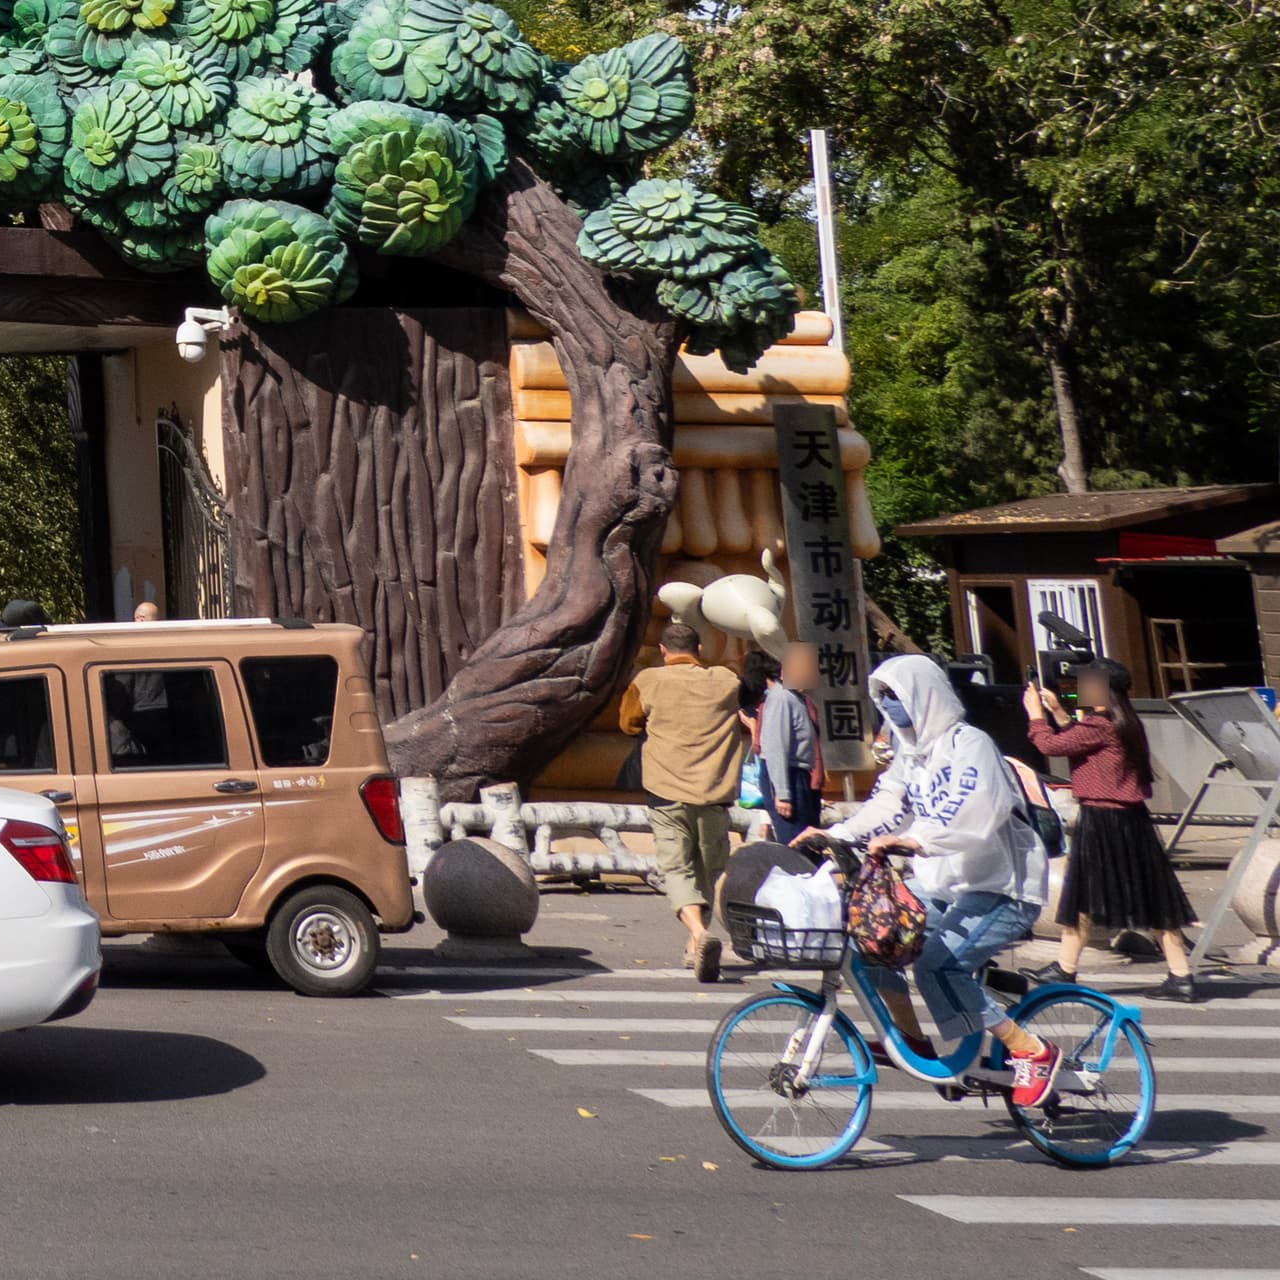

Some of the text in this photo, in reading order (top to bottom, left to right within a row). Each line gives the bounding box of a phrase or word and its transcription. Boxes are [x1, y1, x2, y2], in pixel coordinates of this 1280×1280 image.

[792, 430, 865, 743] 天津市动物园
